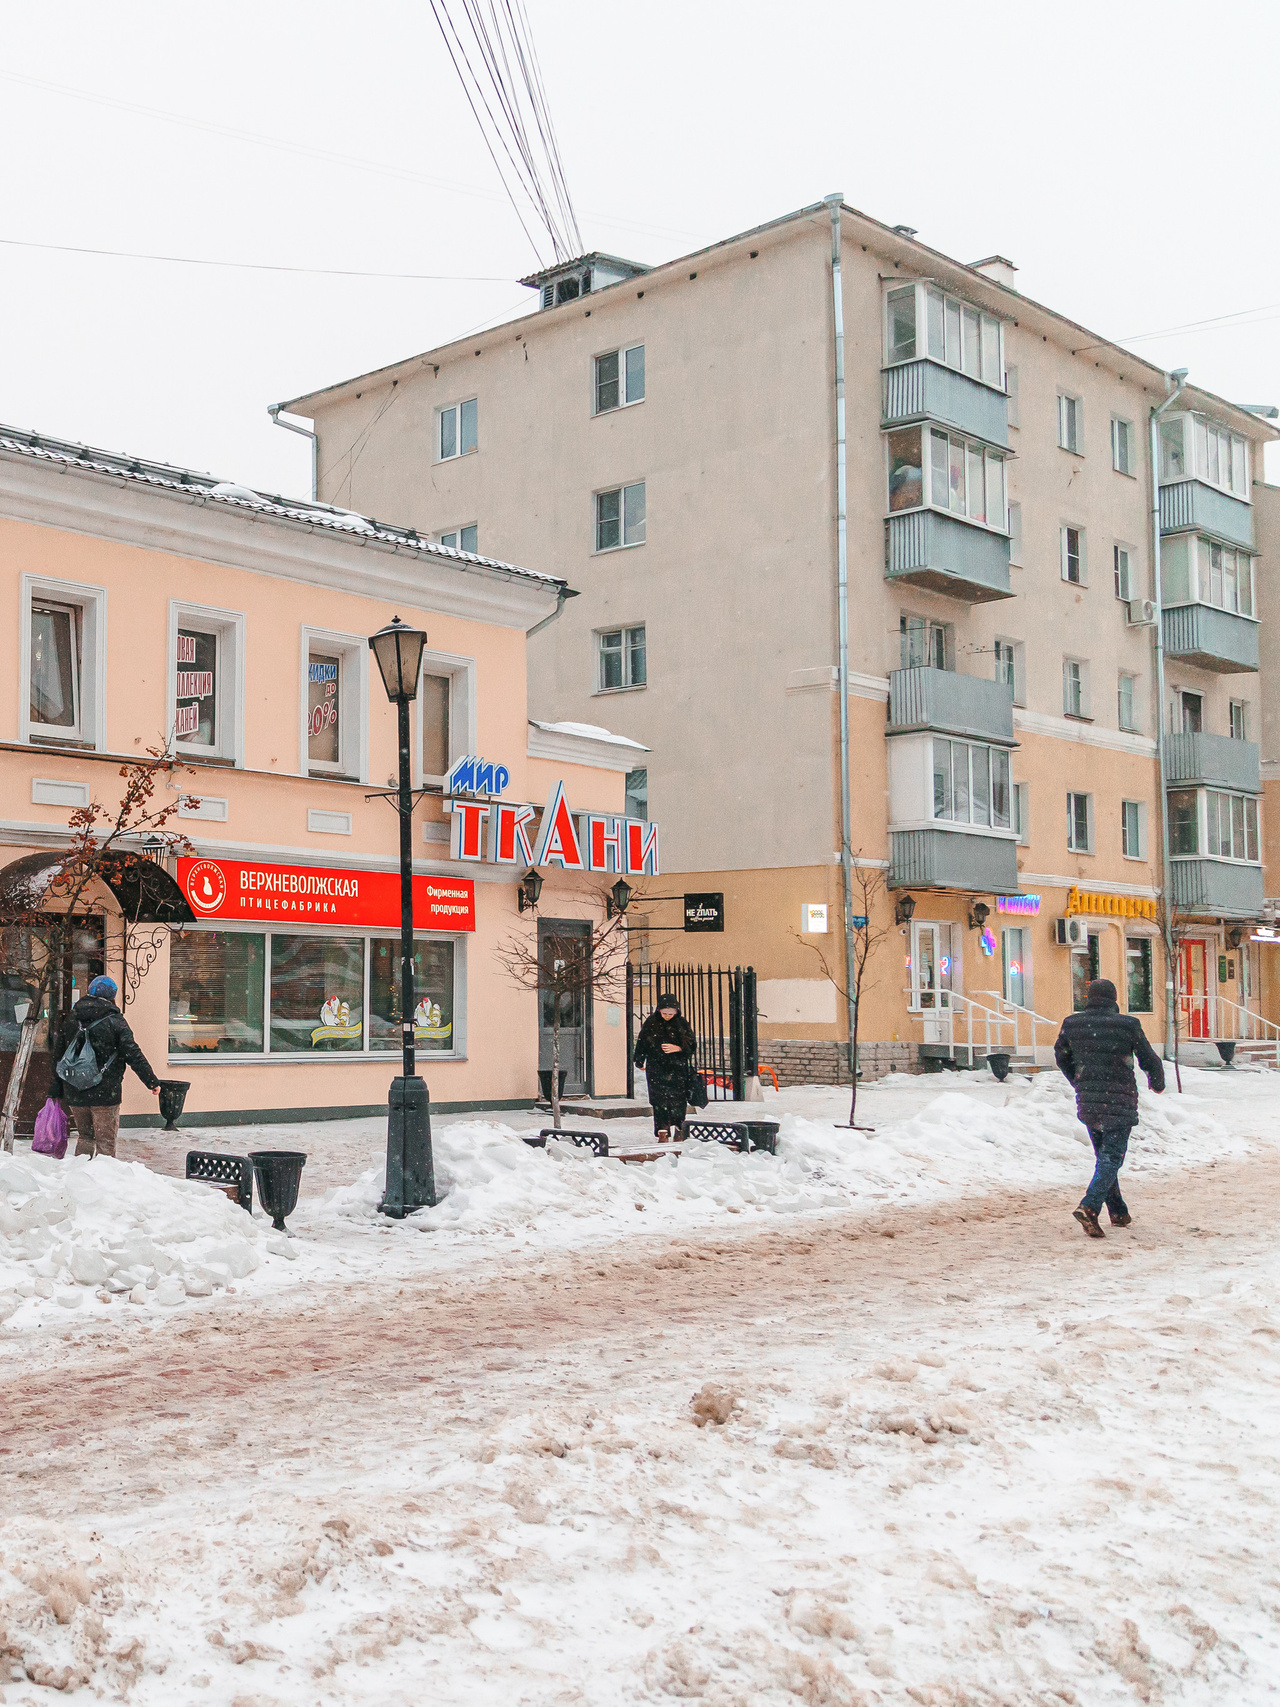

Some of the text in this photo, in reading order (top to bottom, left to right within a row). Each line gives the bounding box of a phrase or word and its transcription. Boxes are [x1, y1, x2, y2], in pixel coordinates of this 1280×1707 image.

[177, 635, 195, 662] ОВАЯ
[177, 672, 211, 700] ОЛЛЕКЦИЯ
[309, 664, 337, 684] КИДКИ
[176, 703, 198, 734] КАНЕЙ
[447, 755, 510, 797] МИР
[448, 780, 660, 876] ТКАНИ
[240, 870, 359, 898] ВЕРХНЕВОЛЖСКАЯ
[426, 885, 469, 899] Фирменная
[240, 896, 337, 913] ПТИЦЕФАБРИКА
[430, 903, 469, 915] продукция
[686, 908, 696, 917] НЕ
